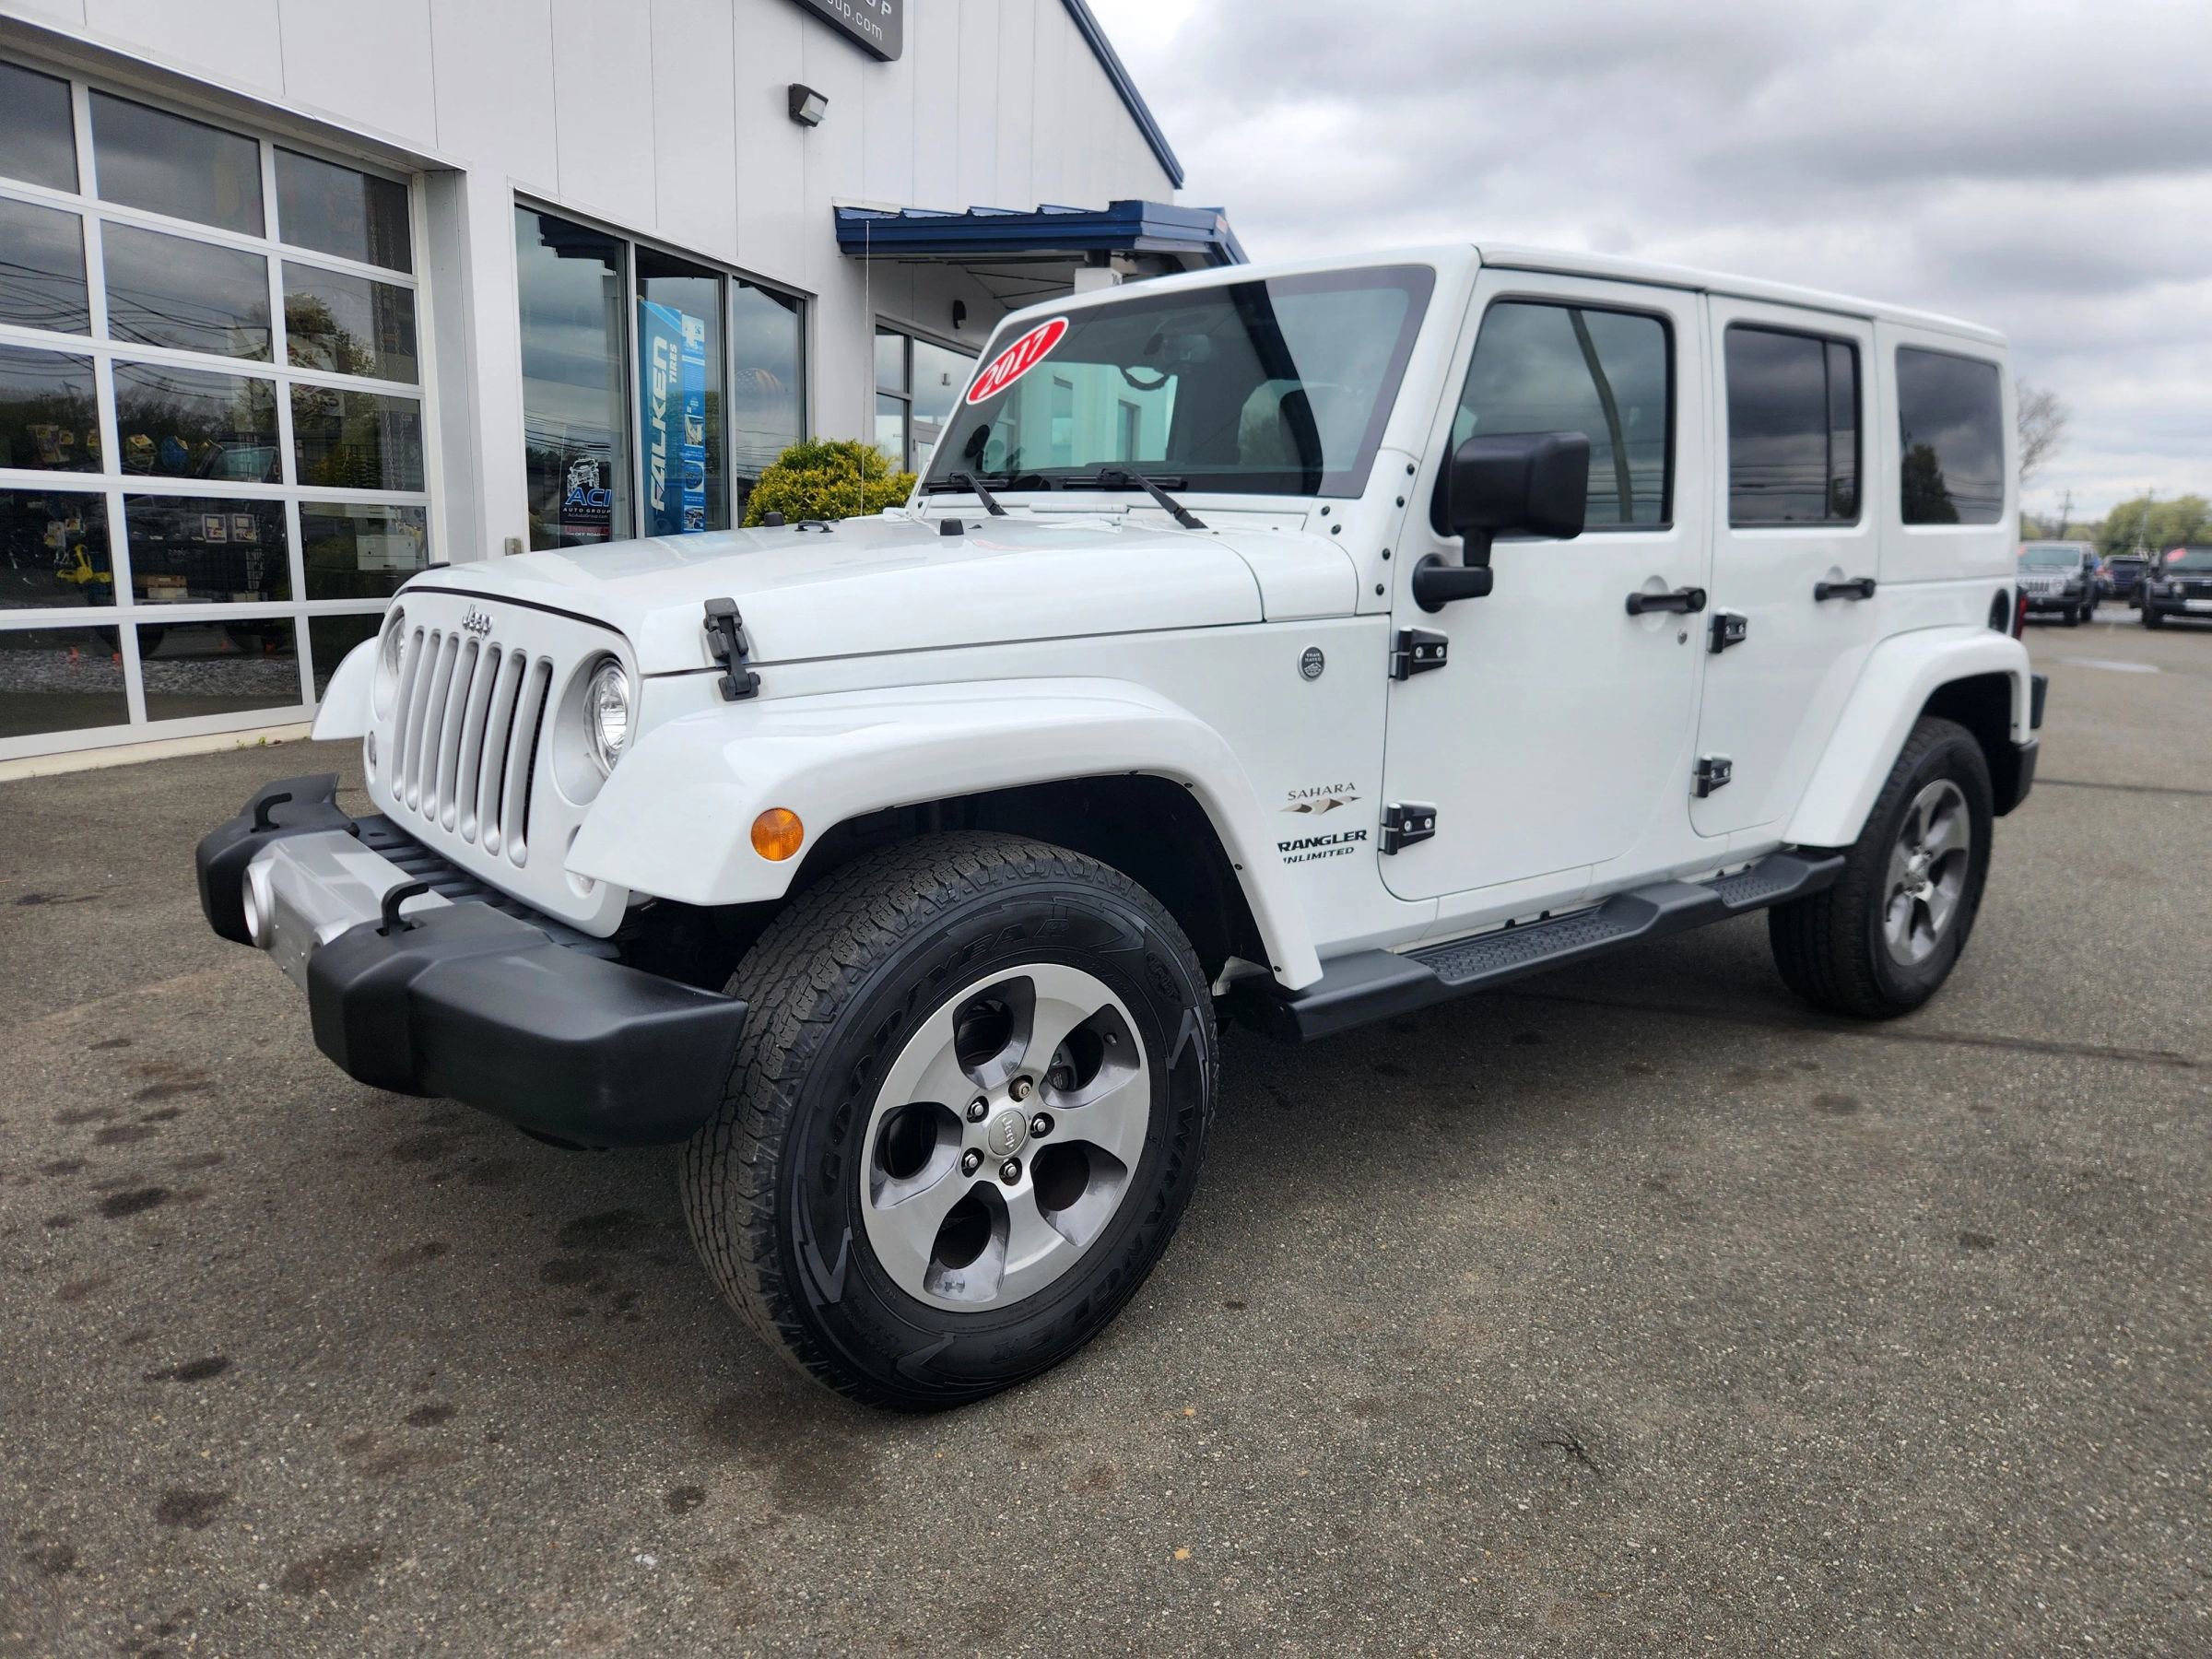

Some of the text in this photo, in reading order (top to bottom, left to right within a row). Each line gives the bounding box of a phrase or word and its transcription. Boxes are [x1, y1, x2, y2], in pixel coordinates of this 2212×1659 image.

[669, 344, 678, 383] TIRES
[977, 325, 1051, 399] 2017
[651, 335, 667, 514] FALKEN
[565, 487, 612, 507] ACI
[462, 604, 493, 641] Jeep
[1288, 782, 1356, 801] SAHARA
[1277, 830, 1367, 853] RANGLER
[1002, 1117, 1015, 1148] Jeep
